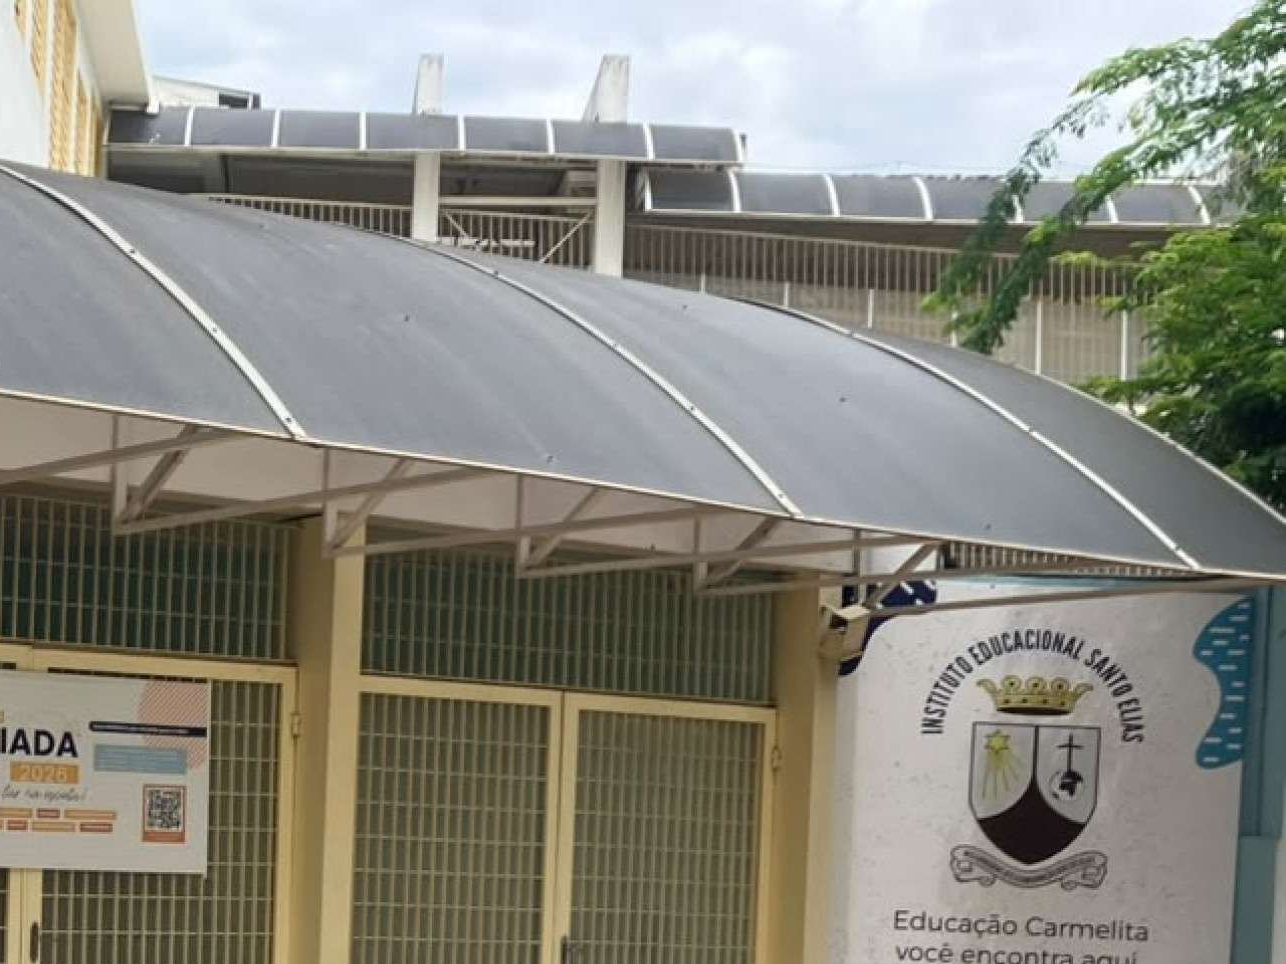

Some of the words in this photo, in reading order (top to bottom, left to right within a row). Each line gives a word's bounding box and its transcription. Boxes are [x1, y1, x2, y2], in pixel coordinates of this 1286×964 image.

[921, 655, 974, 735] INSTITUTO
[968, 627, 1086, 666] EDUCACIONAL
[1084, 647, 1134, 699] SANTO
[1117, 697, 1145, 744] ELIAS
[893, 909, 1018, 939] Educação
[1025, 915, 1150, 942] Carmelita
[895, 942, 954, 964] você
